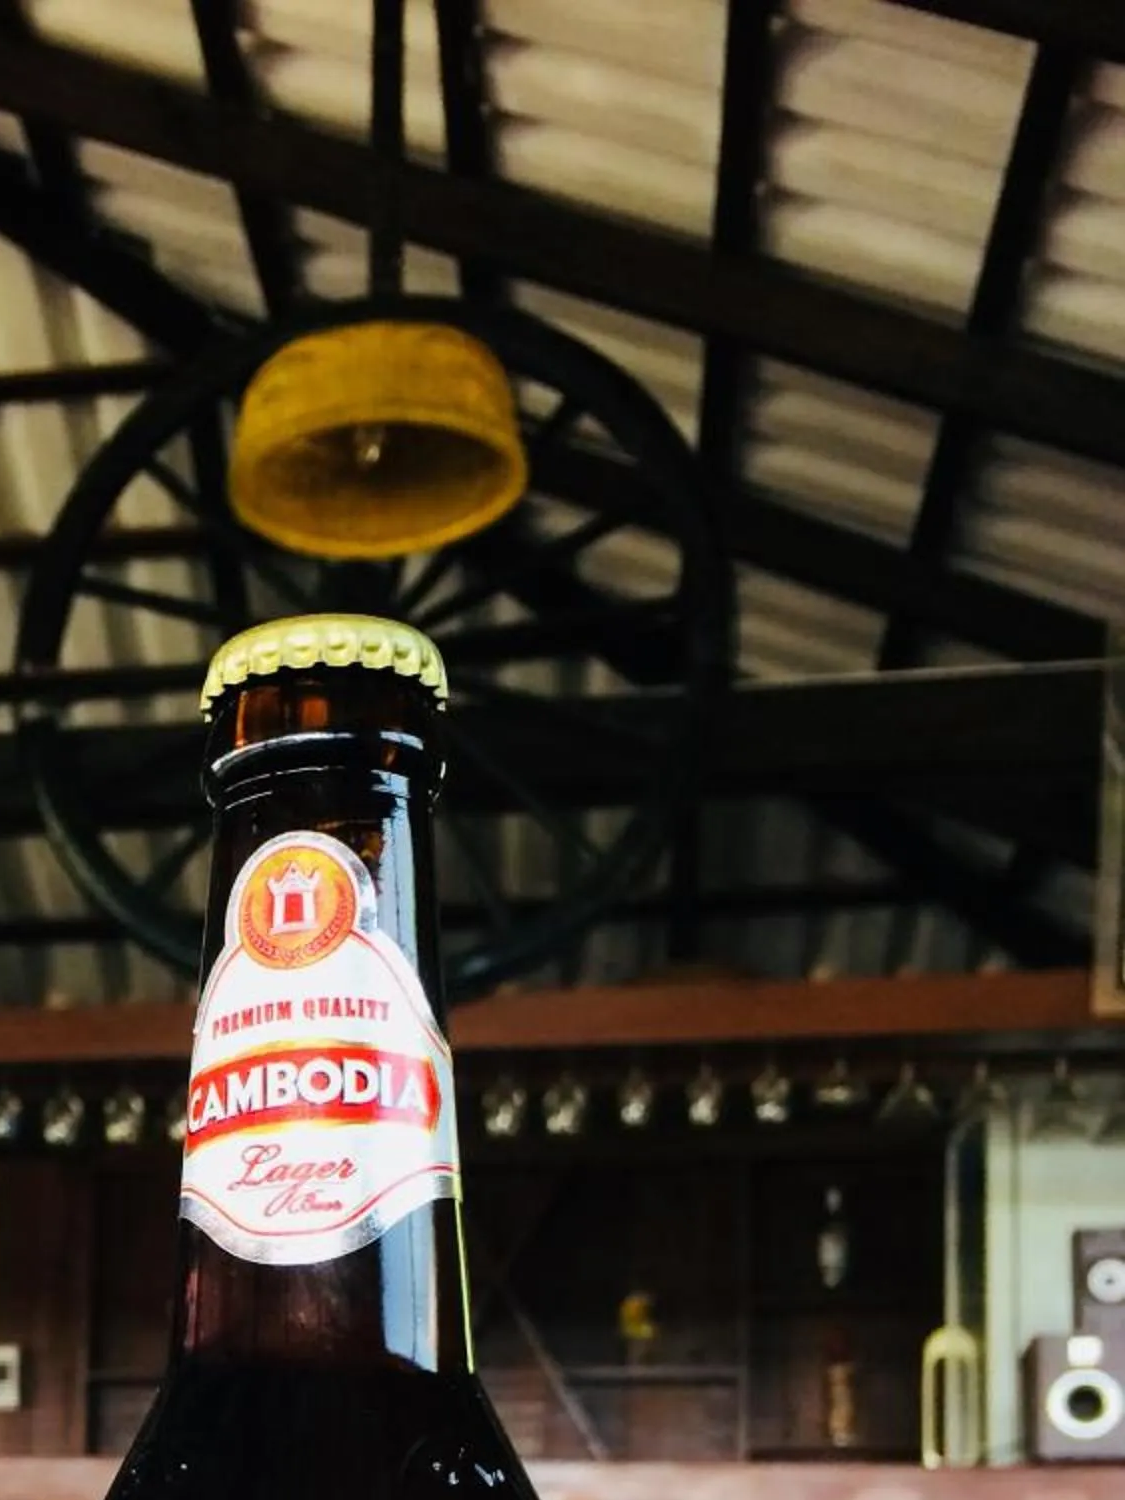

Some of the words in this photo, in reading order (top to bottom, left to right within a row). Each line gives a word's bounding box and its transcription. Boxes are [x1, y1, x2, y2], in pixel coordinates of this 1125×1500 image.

[212, 1000, 292, 1040] PREMIUM
[303, 997, 389, 1021] QUALITY
[187, 1058, 428, 1133] CAMBODIA
[226, 1143, 358, 1217] Lager
